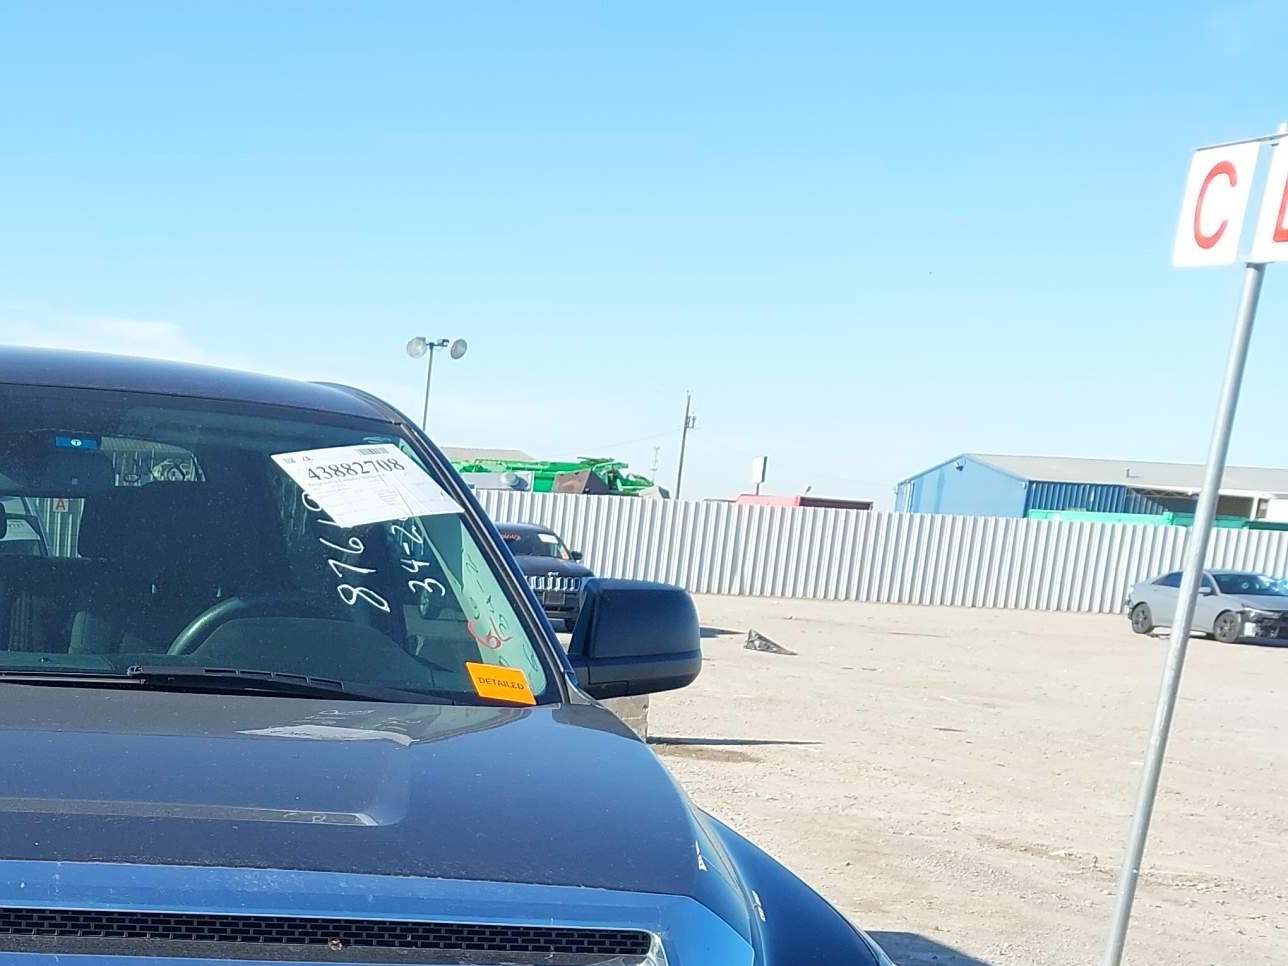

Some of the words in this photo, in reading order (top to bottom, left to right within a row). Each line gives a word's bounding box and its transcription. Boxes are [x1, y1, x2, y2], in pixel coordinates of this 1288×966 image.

[1193, 160, 1238, 250] C
[307, 457, 406, 481] 43882708
[478, 677, 525, 690] DETAILED
